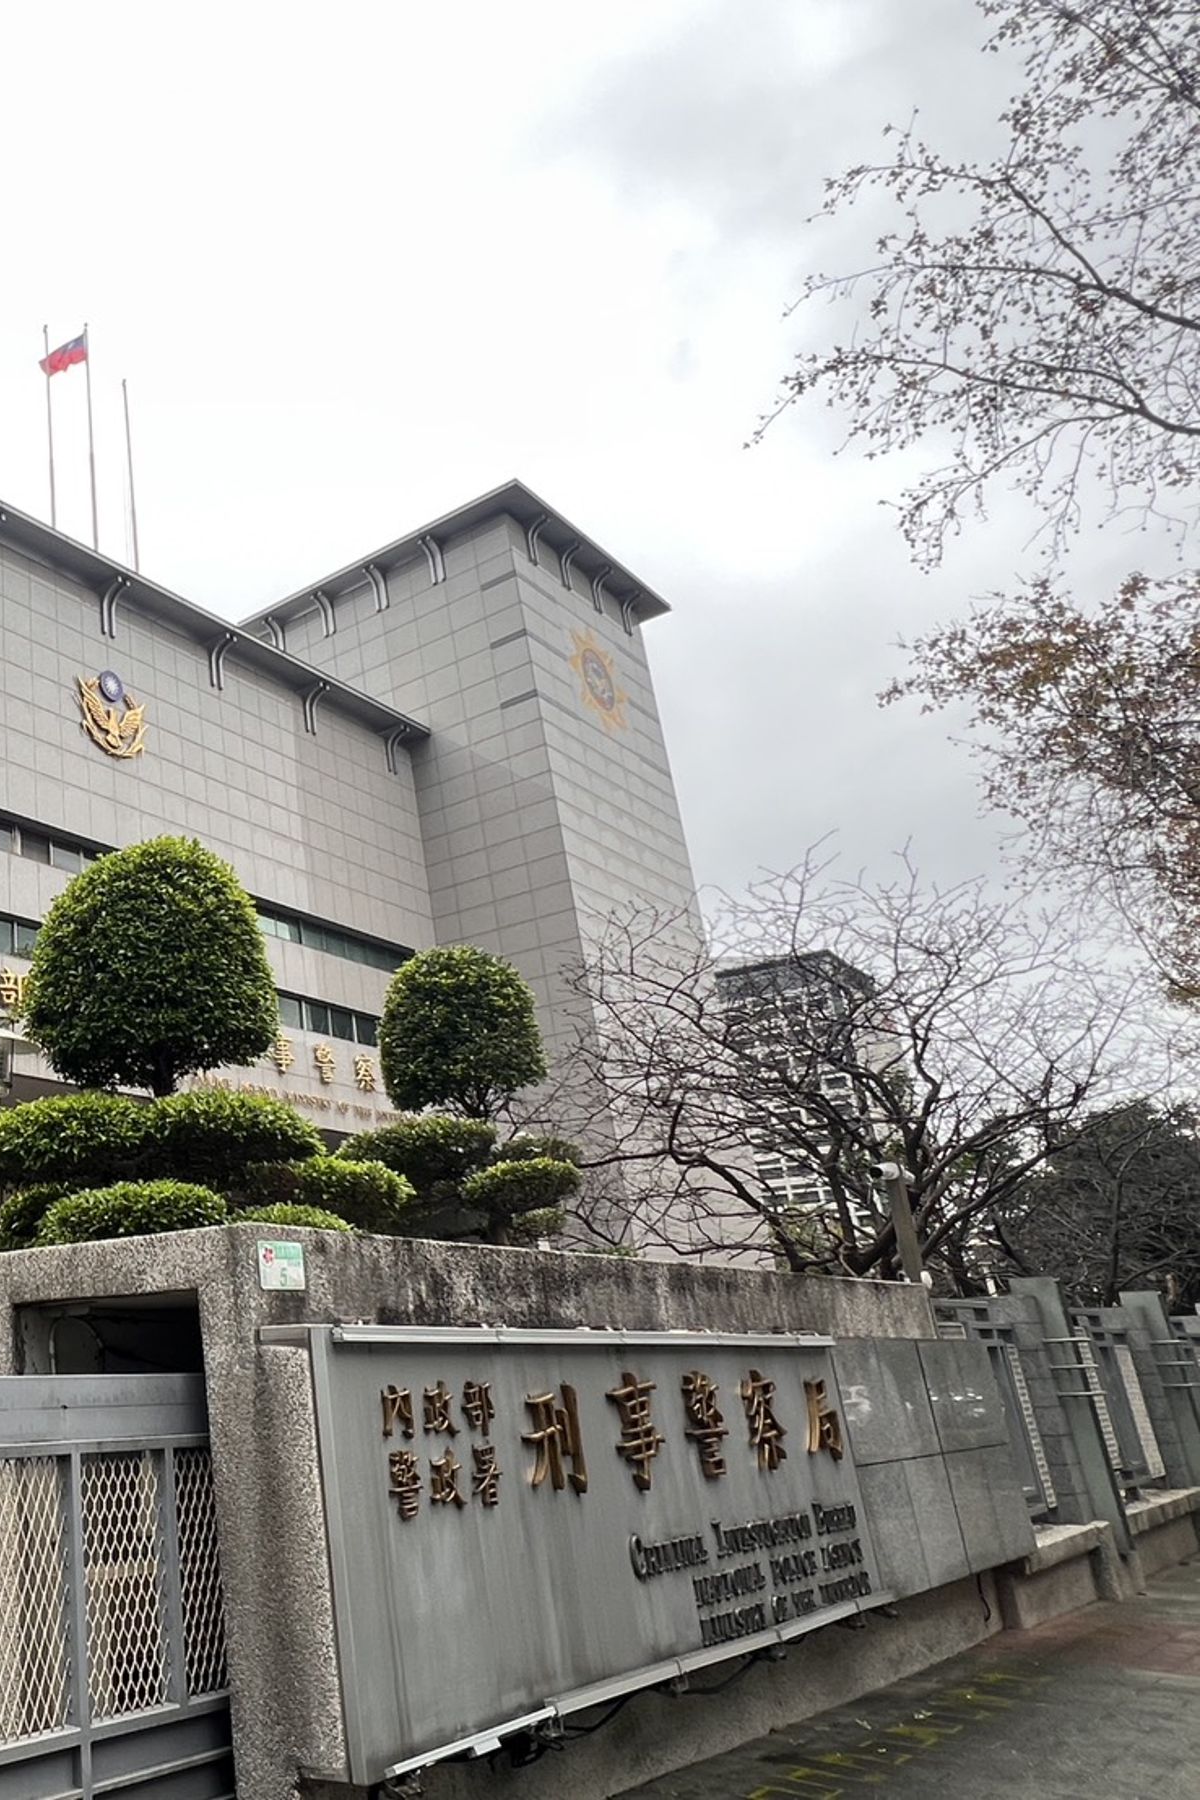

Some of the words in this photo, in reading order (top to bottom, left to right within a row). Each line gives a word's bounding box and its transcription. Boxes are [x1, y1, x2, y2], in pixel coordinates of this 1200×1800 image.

[380, 1380, 496, 1437] 內政部
[521, 1369, 844, 1494] 刑事警察局
[388, 1441, 502, 1520] 警政署
